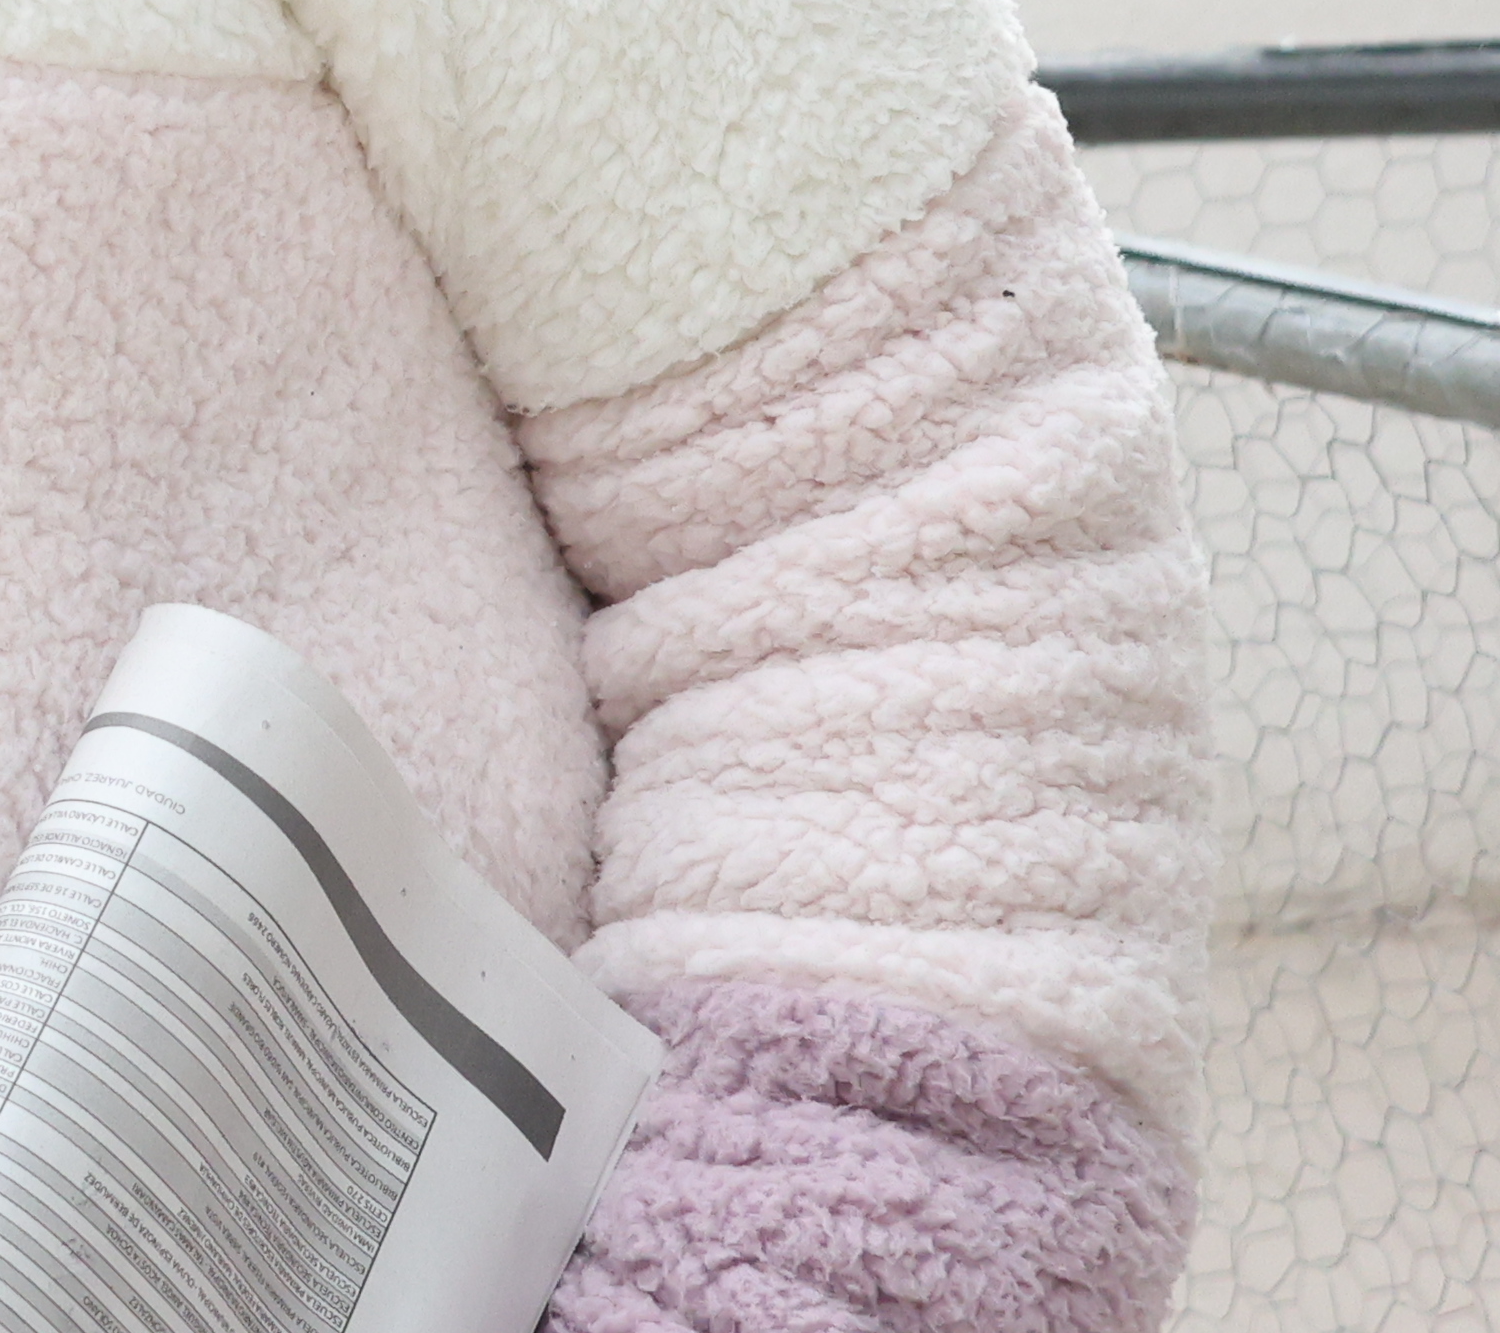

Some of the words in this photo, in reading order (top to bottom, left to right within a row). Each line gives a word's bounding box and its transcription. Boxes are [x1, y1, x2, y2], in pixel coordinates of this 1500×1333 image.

[84, 771, 132, 791] JUÁREZ
[134, 783, 186, 816] CIUDAD
[68, 809, 104, 825] LÁZARO
[106, 817, 139, 837] CALLE
[81, 835, 128, 859] IGNACIO
[45, 853, 83, 868] CAMILO
[84, 860, 116, 881] CALLE
[40, 883, 53, 893] DE
[53, 885, 68, 896] 16
[70, 889, 102, 909] CALLE
[19, 918, 70, 939] HACIENDA
[47, 908, 90, 930] SONETO
[3, 933, 35, 946] MONTE
[37, 939, 75, 960] RIVERA
[22, 984, 53, 1003] CALLE
[12, 999, 45, 1019] CALLE
[357, 1058, 391, 1097] PRIMARIA
[390, 1093, 427, 1128] ESCUELA
[346, 1184, 362, 1203] 270
[128, 1213, 138, 1228] DE
[344, 1202, 380, 1238] ESCUELA
[363, 1199, 387, 1223] CETIS
[328, 1239, 364, 1274] ESCUELA
[317, 1263, 357, 1298] ESCUELA
[311, 1276, 349, 1314] ESCUELA
[304, 1294, 343, 1329] ESCUELA
